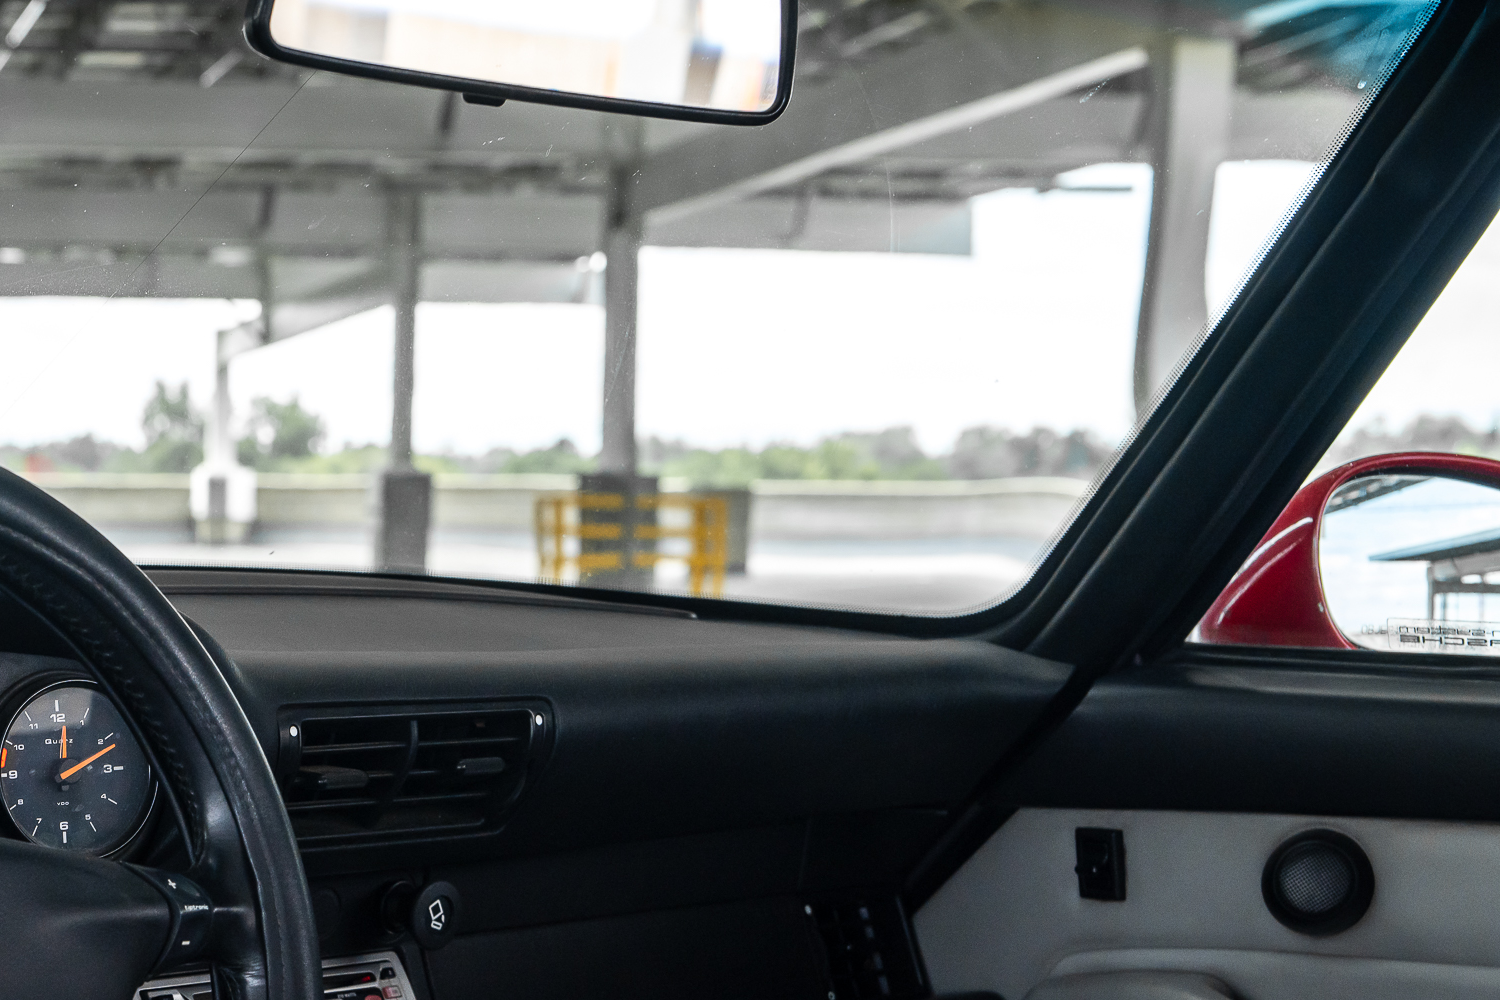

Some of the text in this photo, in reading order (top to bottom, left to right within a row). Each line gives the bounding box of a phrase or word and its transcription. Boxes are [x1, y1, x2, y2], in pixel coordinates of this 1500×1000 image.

[49, 713, 66, 723] 12
[103, 764, 113, 774] 3
[8, 770, 18, 780] 9
[17, 798, 24, 806] 8
[59, 821, 69, 830] 6
